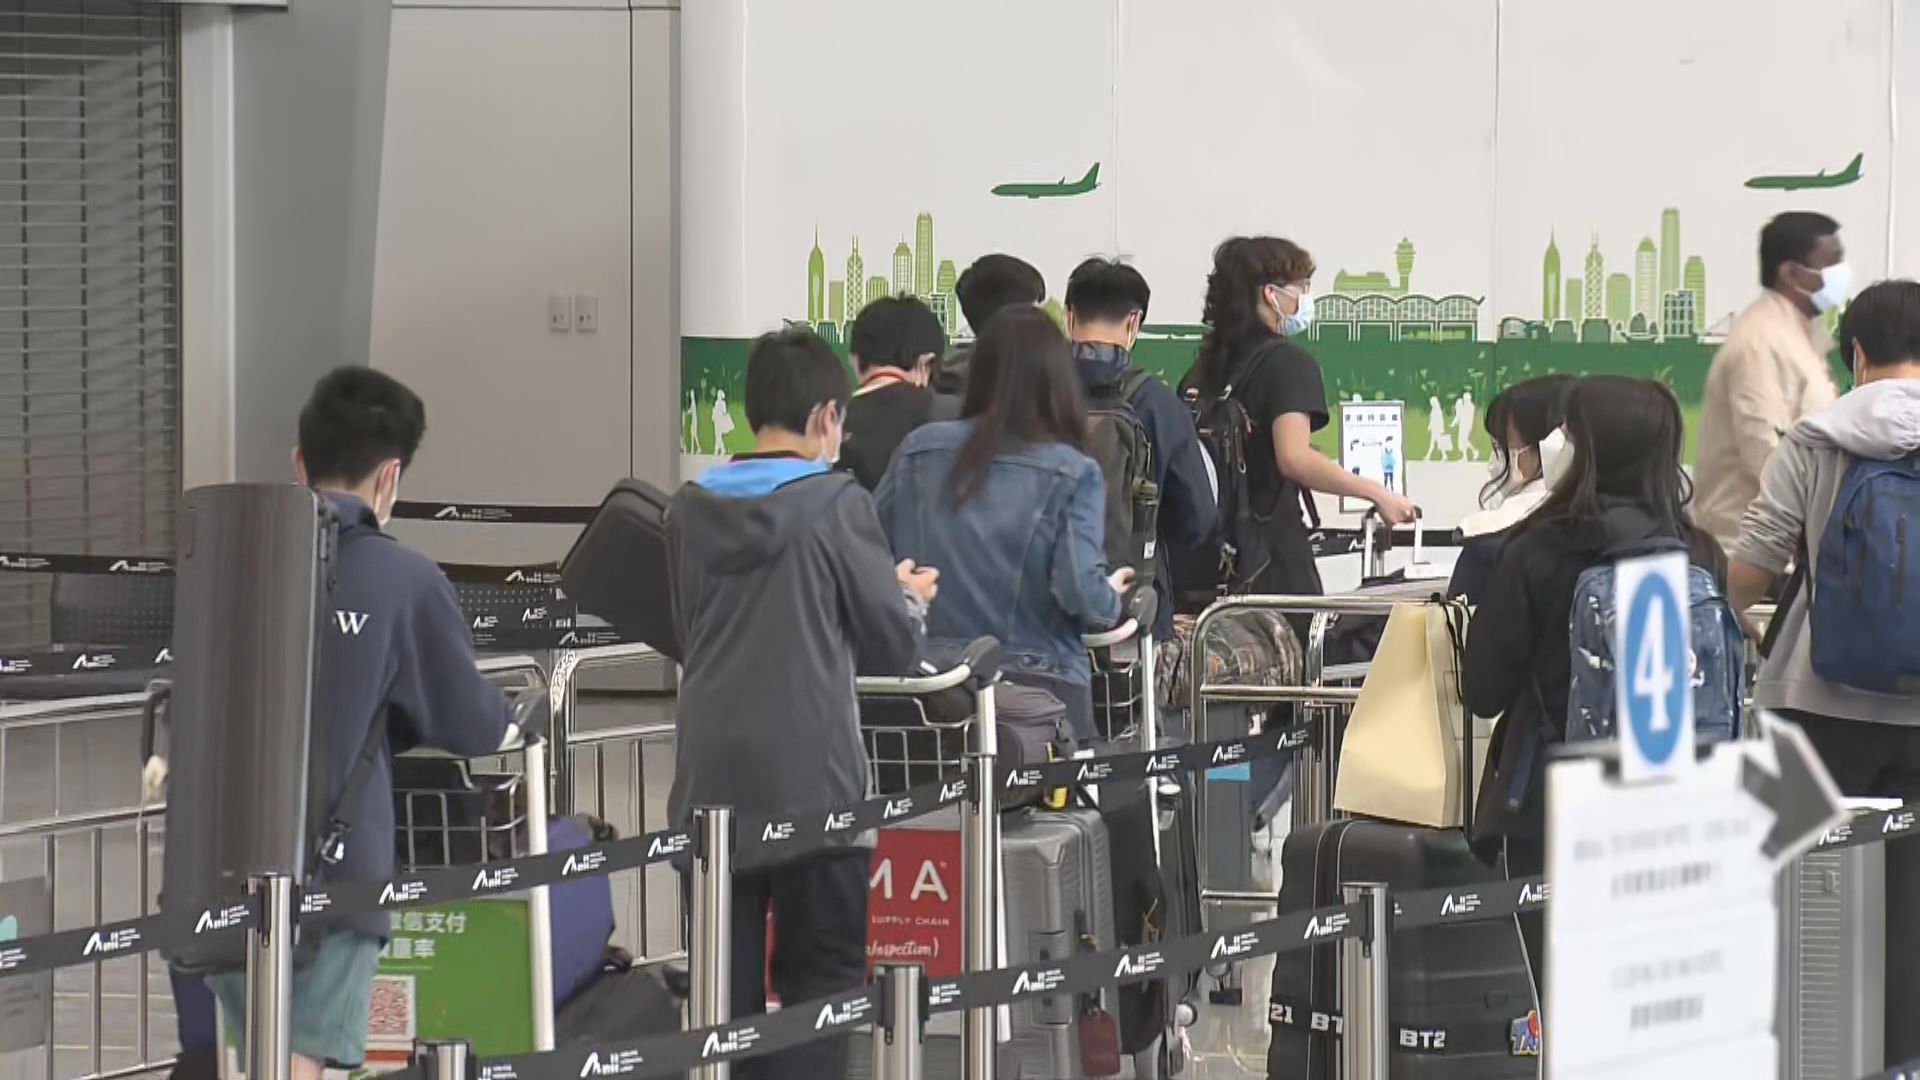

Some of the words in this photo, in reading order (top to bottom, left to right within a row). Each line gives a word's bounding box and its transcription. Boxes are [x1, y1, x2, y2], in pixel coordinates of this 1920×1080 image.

[336, 610, 370, 635] W
[1634, 594, 1674, 731] 4
[915, 916, 950, 927] CHAIN
[1399, 1028, 1446, 1049] BT2
